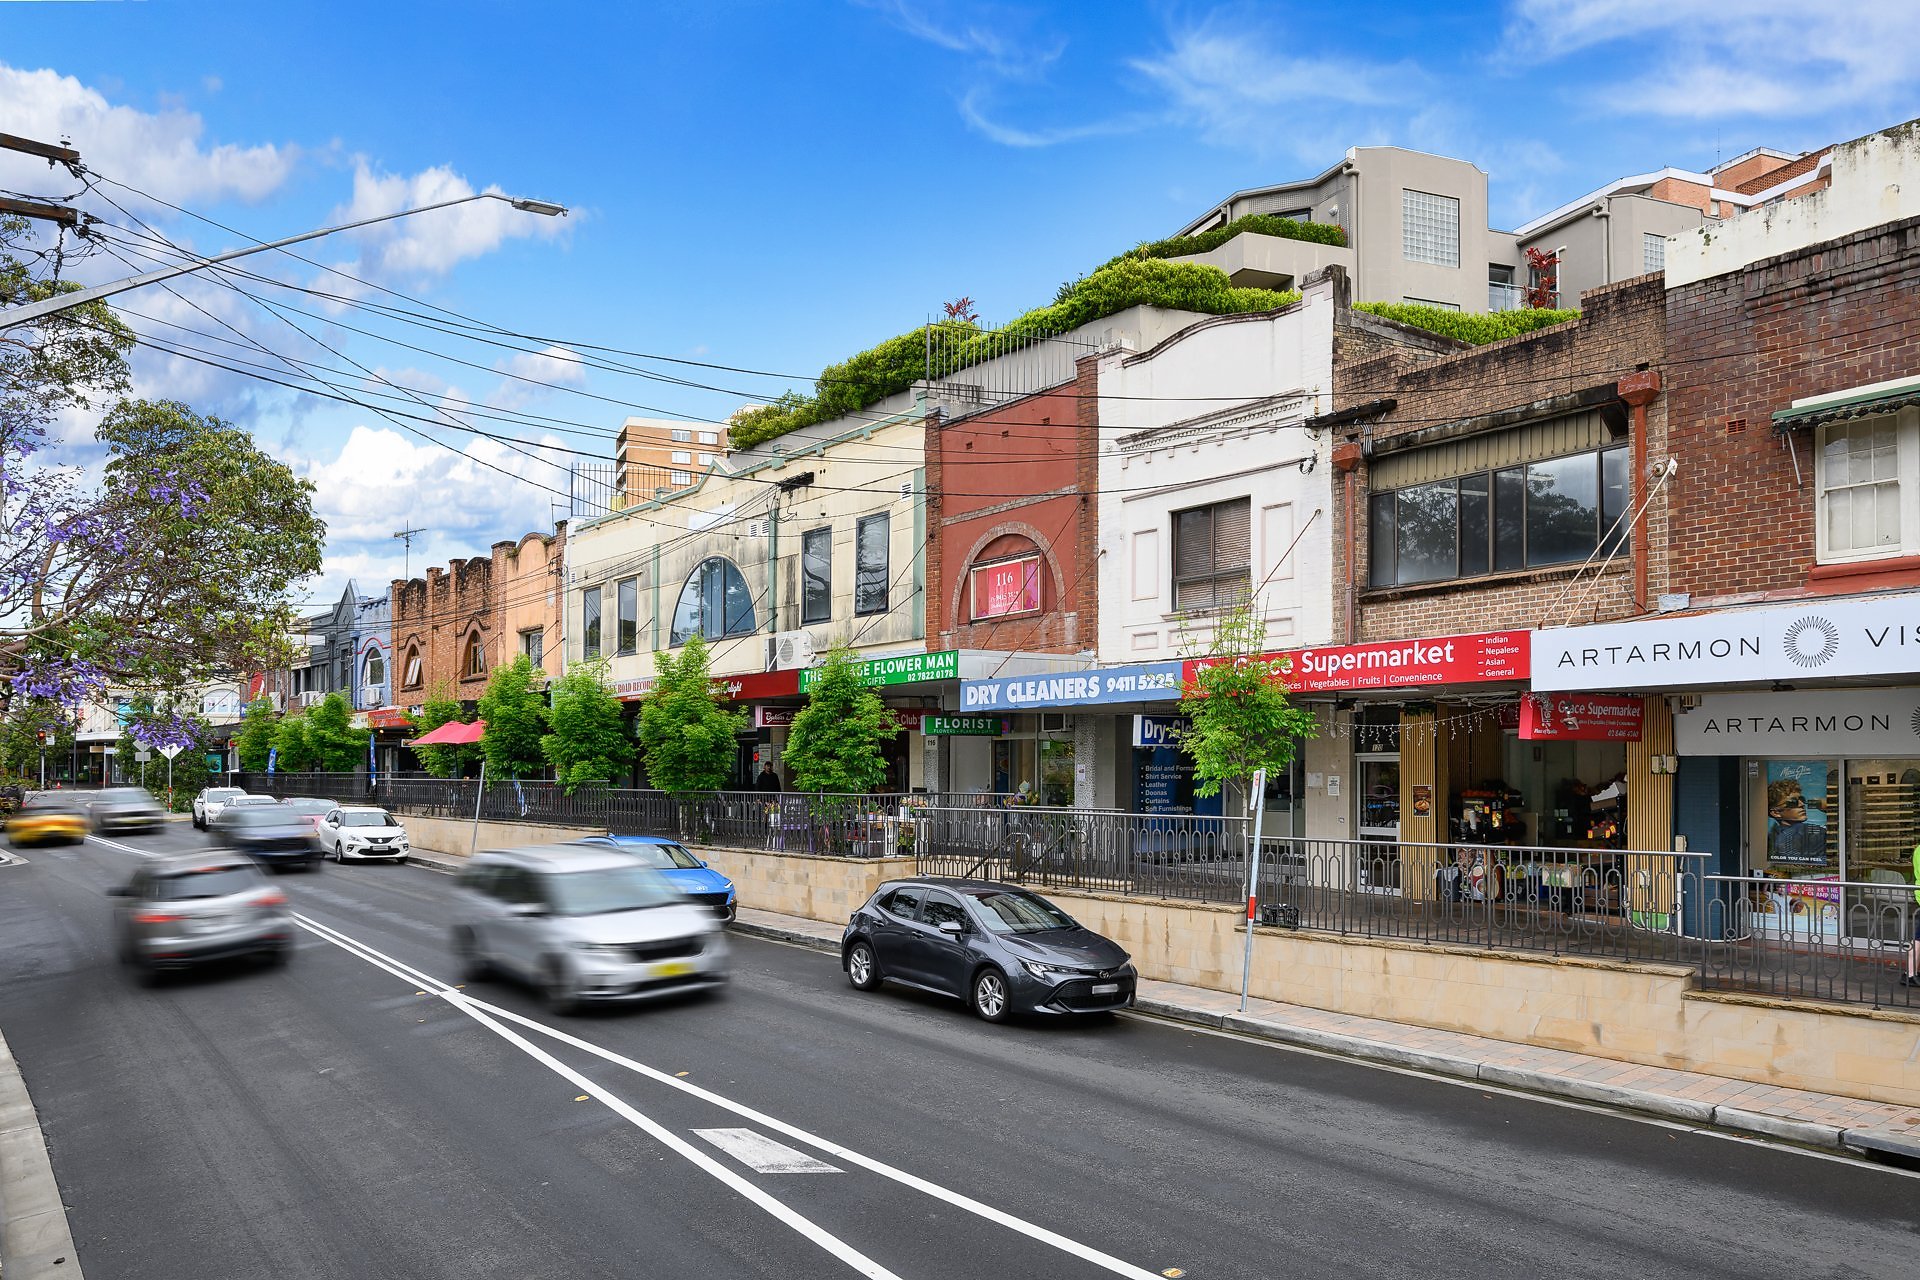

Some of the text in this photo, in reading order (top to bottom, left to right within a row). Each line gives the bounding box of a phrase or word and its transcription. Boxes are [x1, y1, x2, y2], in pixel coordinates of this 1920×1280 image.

[997, 571, 1013, 586] 116
[1486, 636, 1508, 644] Indian
[1301, 641, 1454, 677] Supermarket
[1486, 646, 1519, 655] Nepalese
[1558, 637, 1760, 668] ARTARMON
[804, 669, 823, 682] THE
[874, 657, 922, 675] FLOWER
[926, 654, 954, 668] MAN
[1486, 658, 1505, 666] Asian
[867, 669, 954, 686] GIFTS 02 7822 0178
[1486, 667, 1514, 677] General
[966, 672, 1175, 706] DRY CLEANERS 9411 5225
[1309, 677, 1349, 690] Vegetables
[1358, 675, 1380, 685] Fruits
[1389, 673, 1443, 683] Convenience
[1587, 702, 1640, 718] Supermarket
[935, 717, 993, 729] FLORIST
[1144, 719, 1167, 743] Dry
[1704, 714, 1889, 733] ARTARMON
